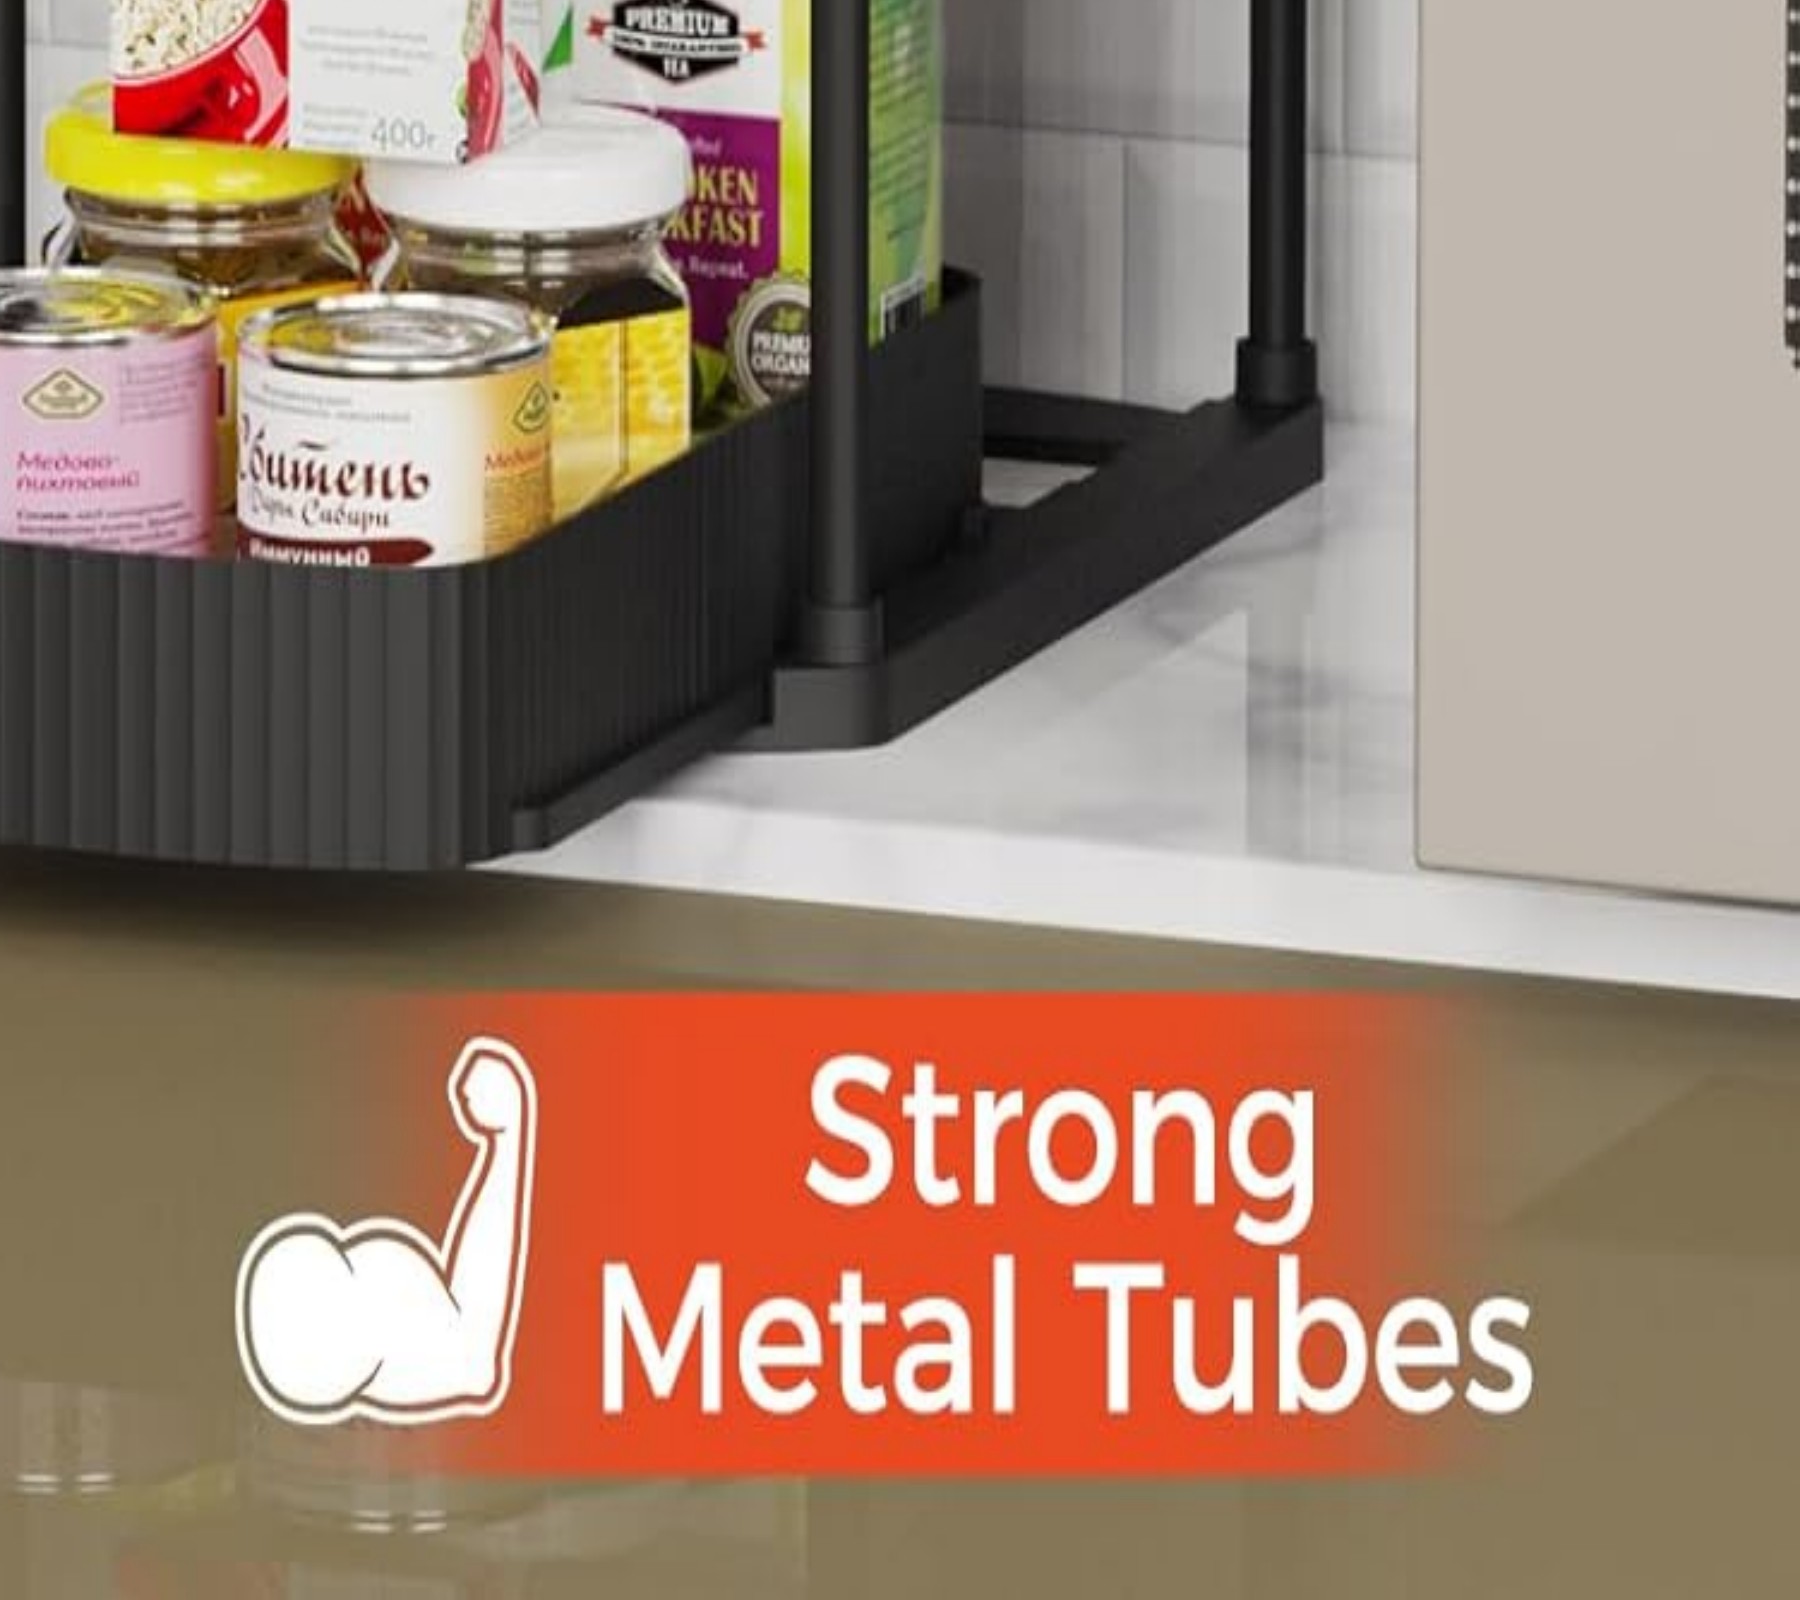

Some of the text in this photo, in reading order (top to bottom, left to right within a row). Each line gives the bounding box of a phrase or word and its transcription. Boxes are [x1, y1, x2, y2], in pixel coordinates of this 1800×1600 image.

[625, 6, 729, 36] PREMIUM
[662, 56, 690, 78] TEA
[752, 330, 812, 355] PREMIU
[750, 352, 811, 376] ORGAN
